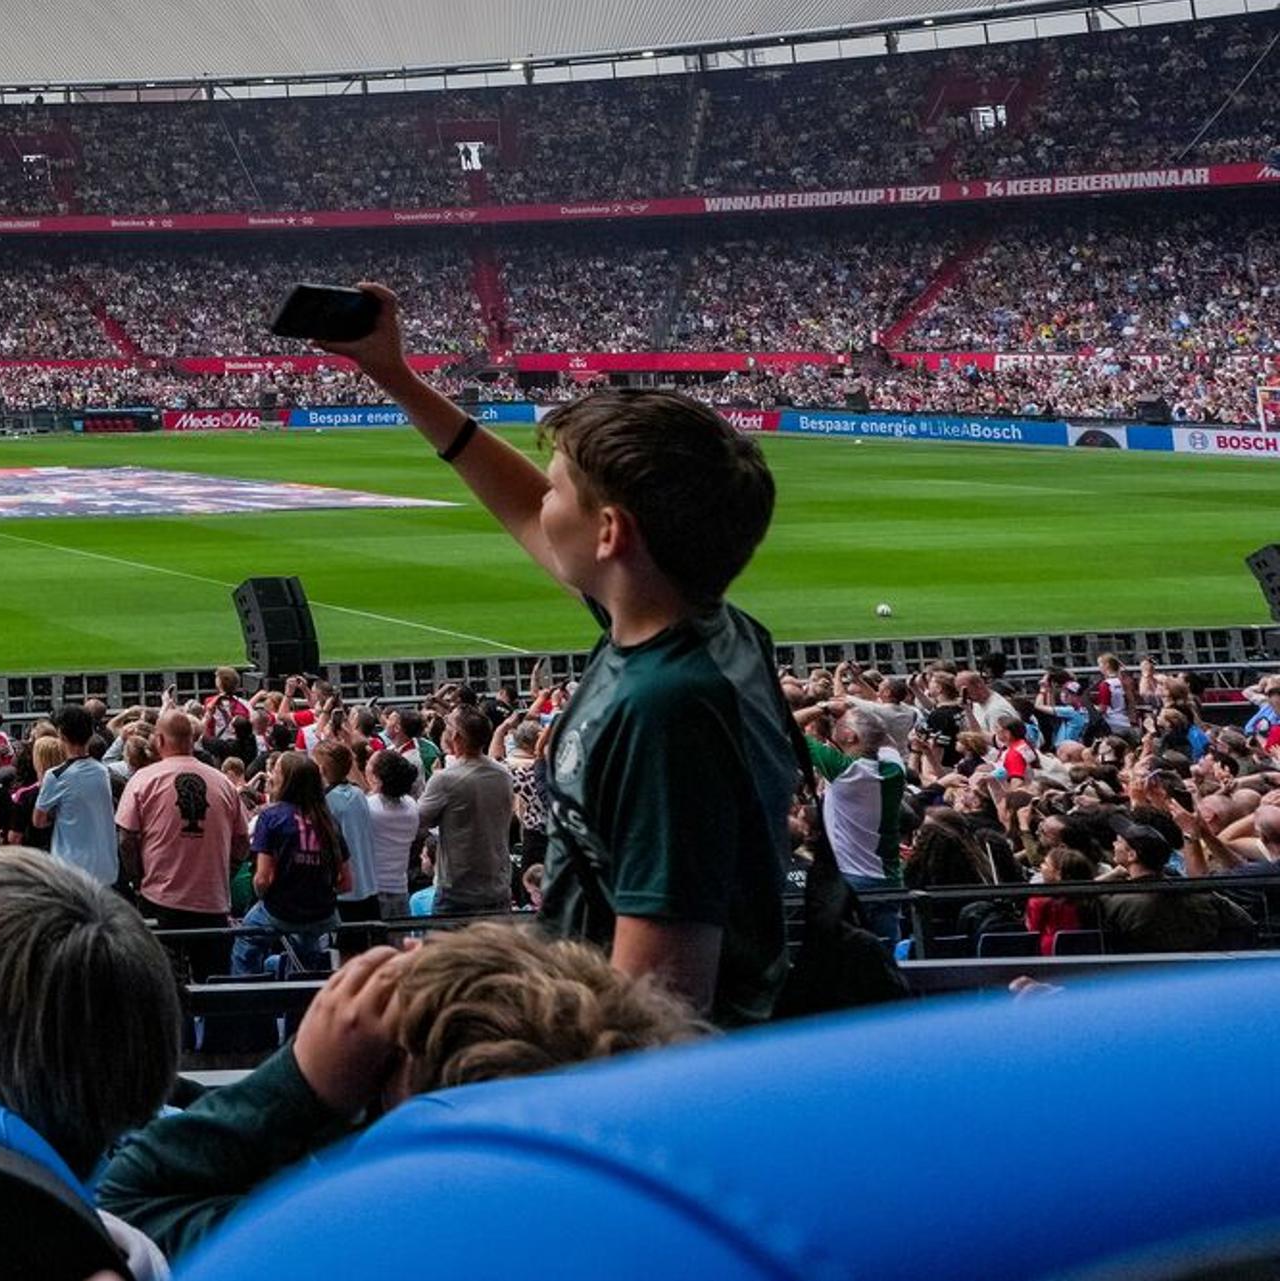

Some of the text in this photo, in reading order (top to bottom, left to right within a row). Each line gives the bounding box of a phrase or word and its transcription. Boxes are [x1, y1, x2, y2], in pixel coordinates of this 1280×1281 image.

[1007, 177, 1052, 196] KEER
[1054, 168, 1210, 193] BEKERWINNAAR
[704, 193, 786, 212] WINNAAR
[787, 187, 885, 208] EUROPACUP
[898, 184, 940, 203] 1970
[309, 412, 408, 426] Bespaar energ
[799, 416, 1022, 439] Bespaar energie #LikeABosch
[1216, 435, 1278, 451] BOSCH
